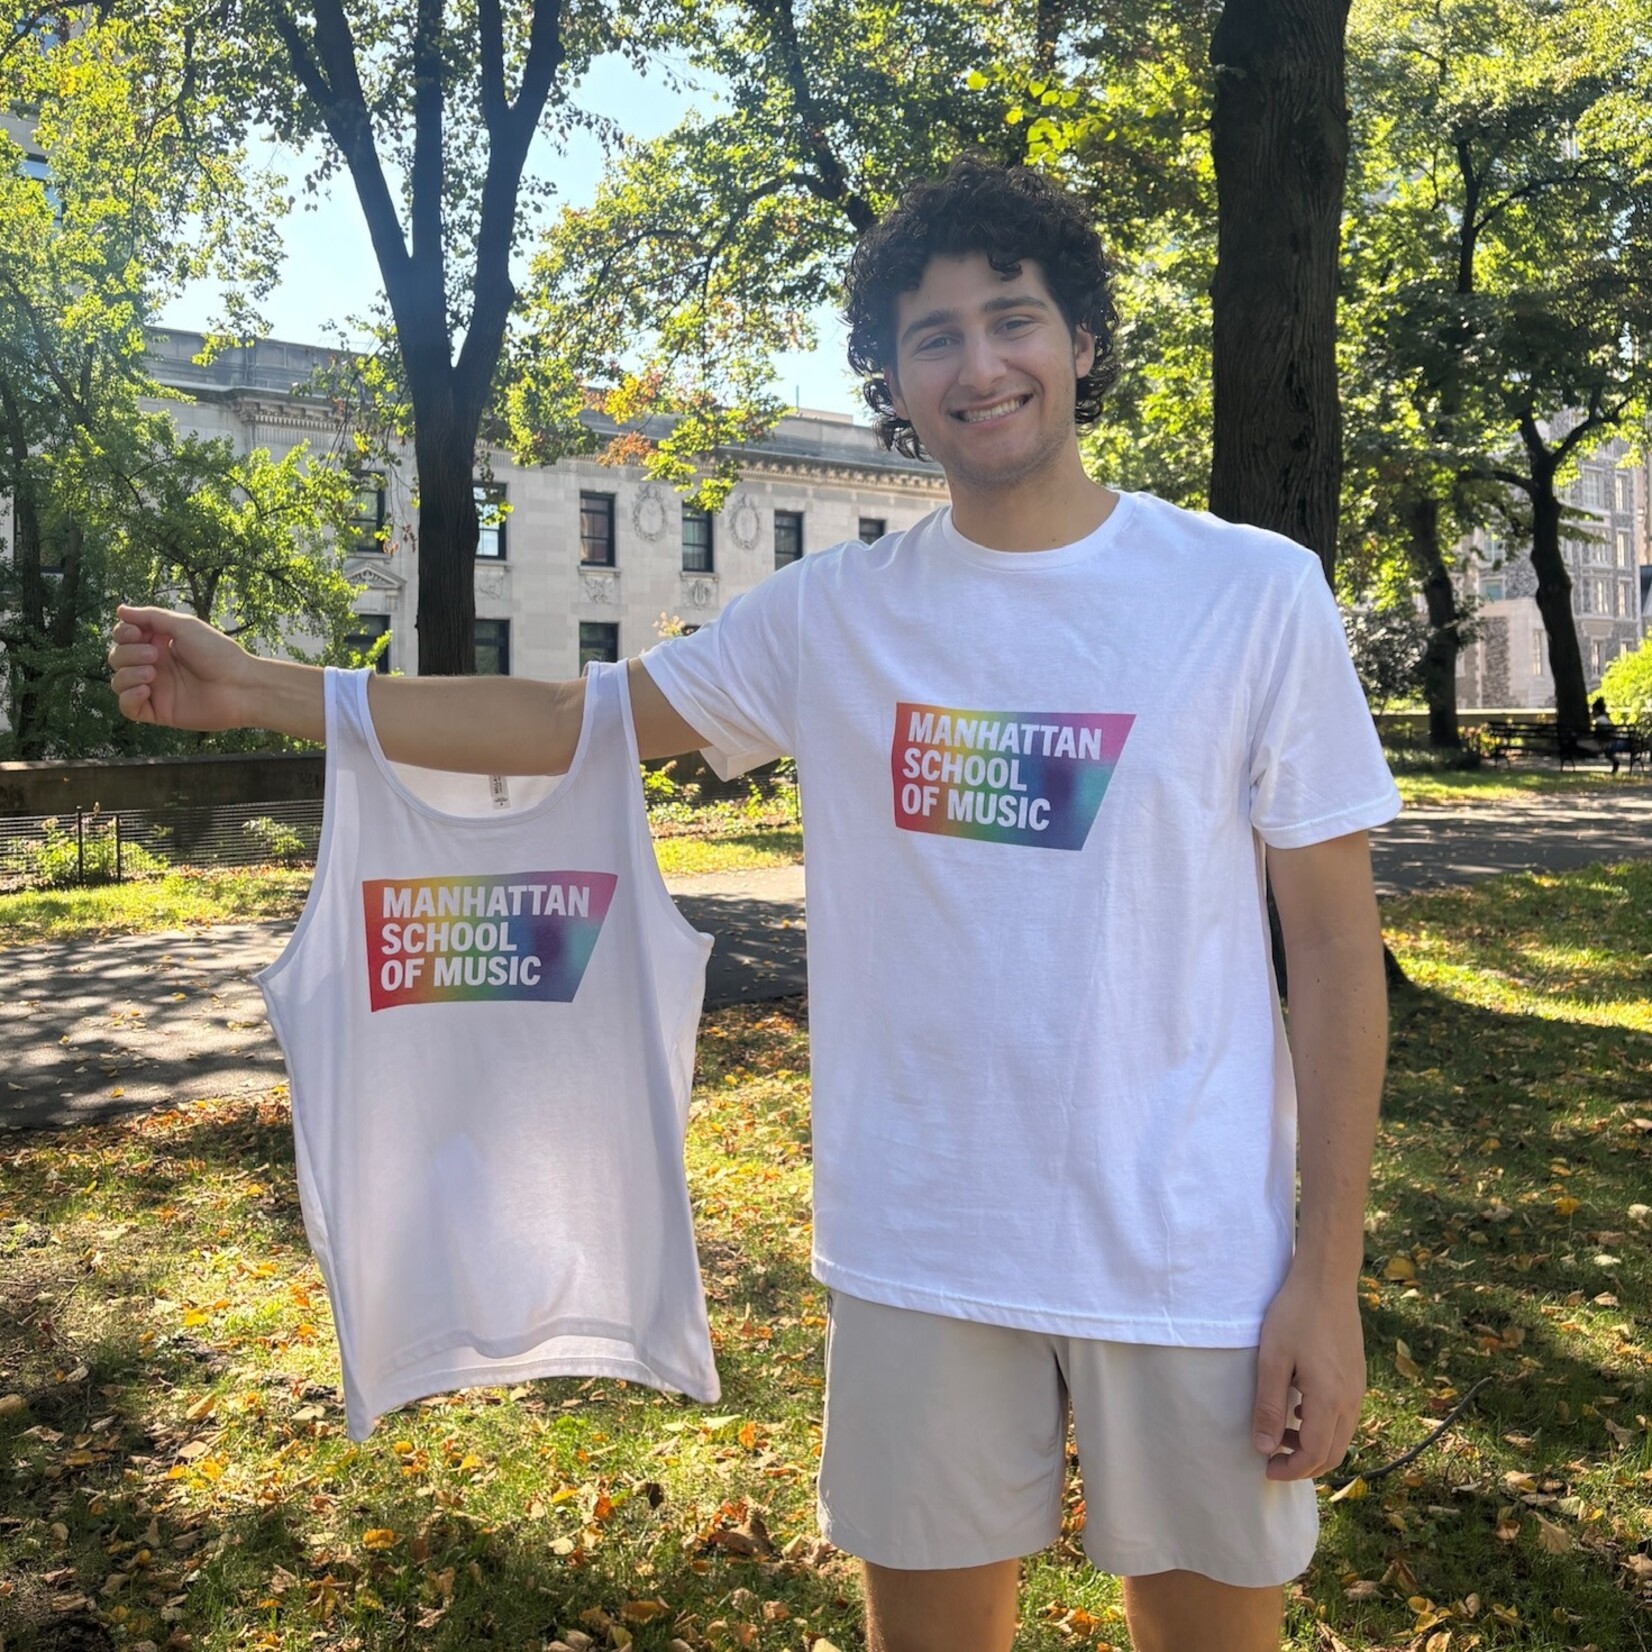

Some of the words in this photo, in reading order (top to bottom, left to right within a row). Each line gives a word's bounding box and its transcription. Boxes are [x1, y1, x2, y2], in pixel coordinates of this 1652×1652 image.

[908, 711, 1102, 761] MANHATTAN
[902, 747, 1027, 792] SCHOOL
[901, 783, 940, 817] OF
[947, 789, 1050, 831] MUSIC
[382, 884, 590, 918] MANHATTAN
[381, 921, 518, 955] SCHOOL
[380, 958, 425, 991] OF
[433, 955, 542, 987] MUSIC
